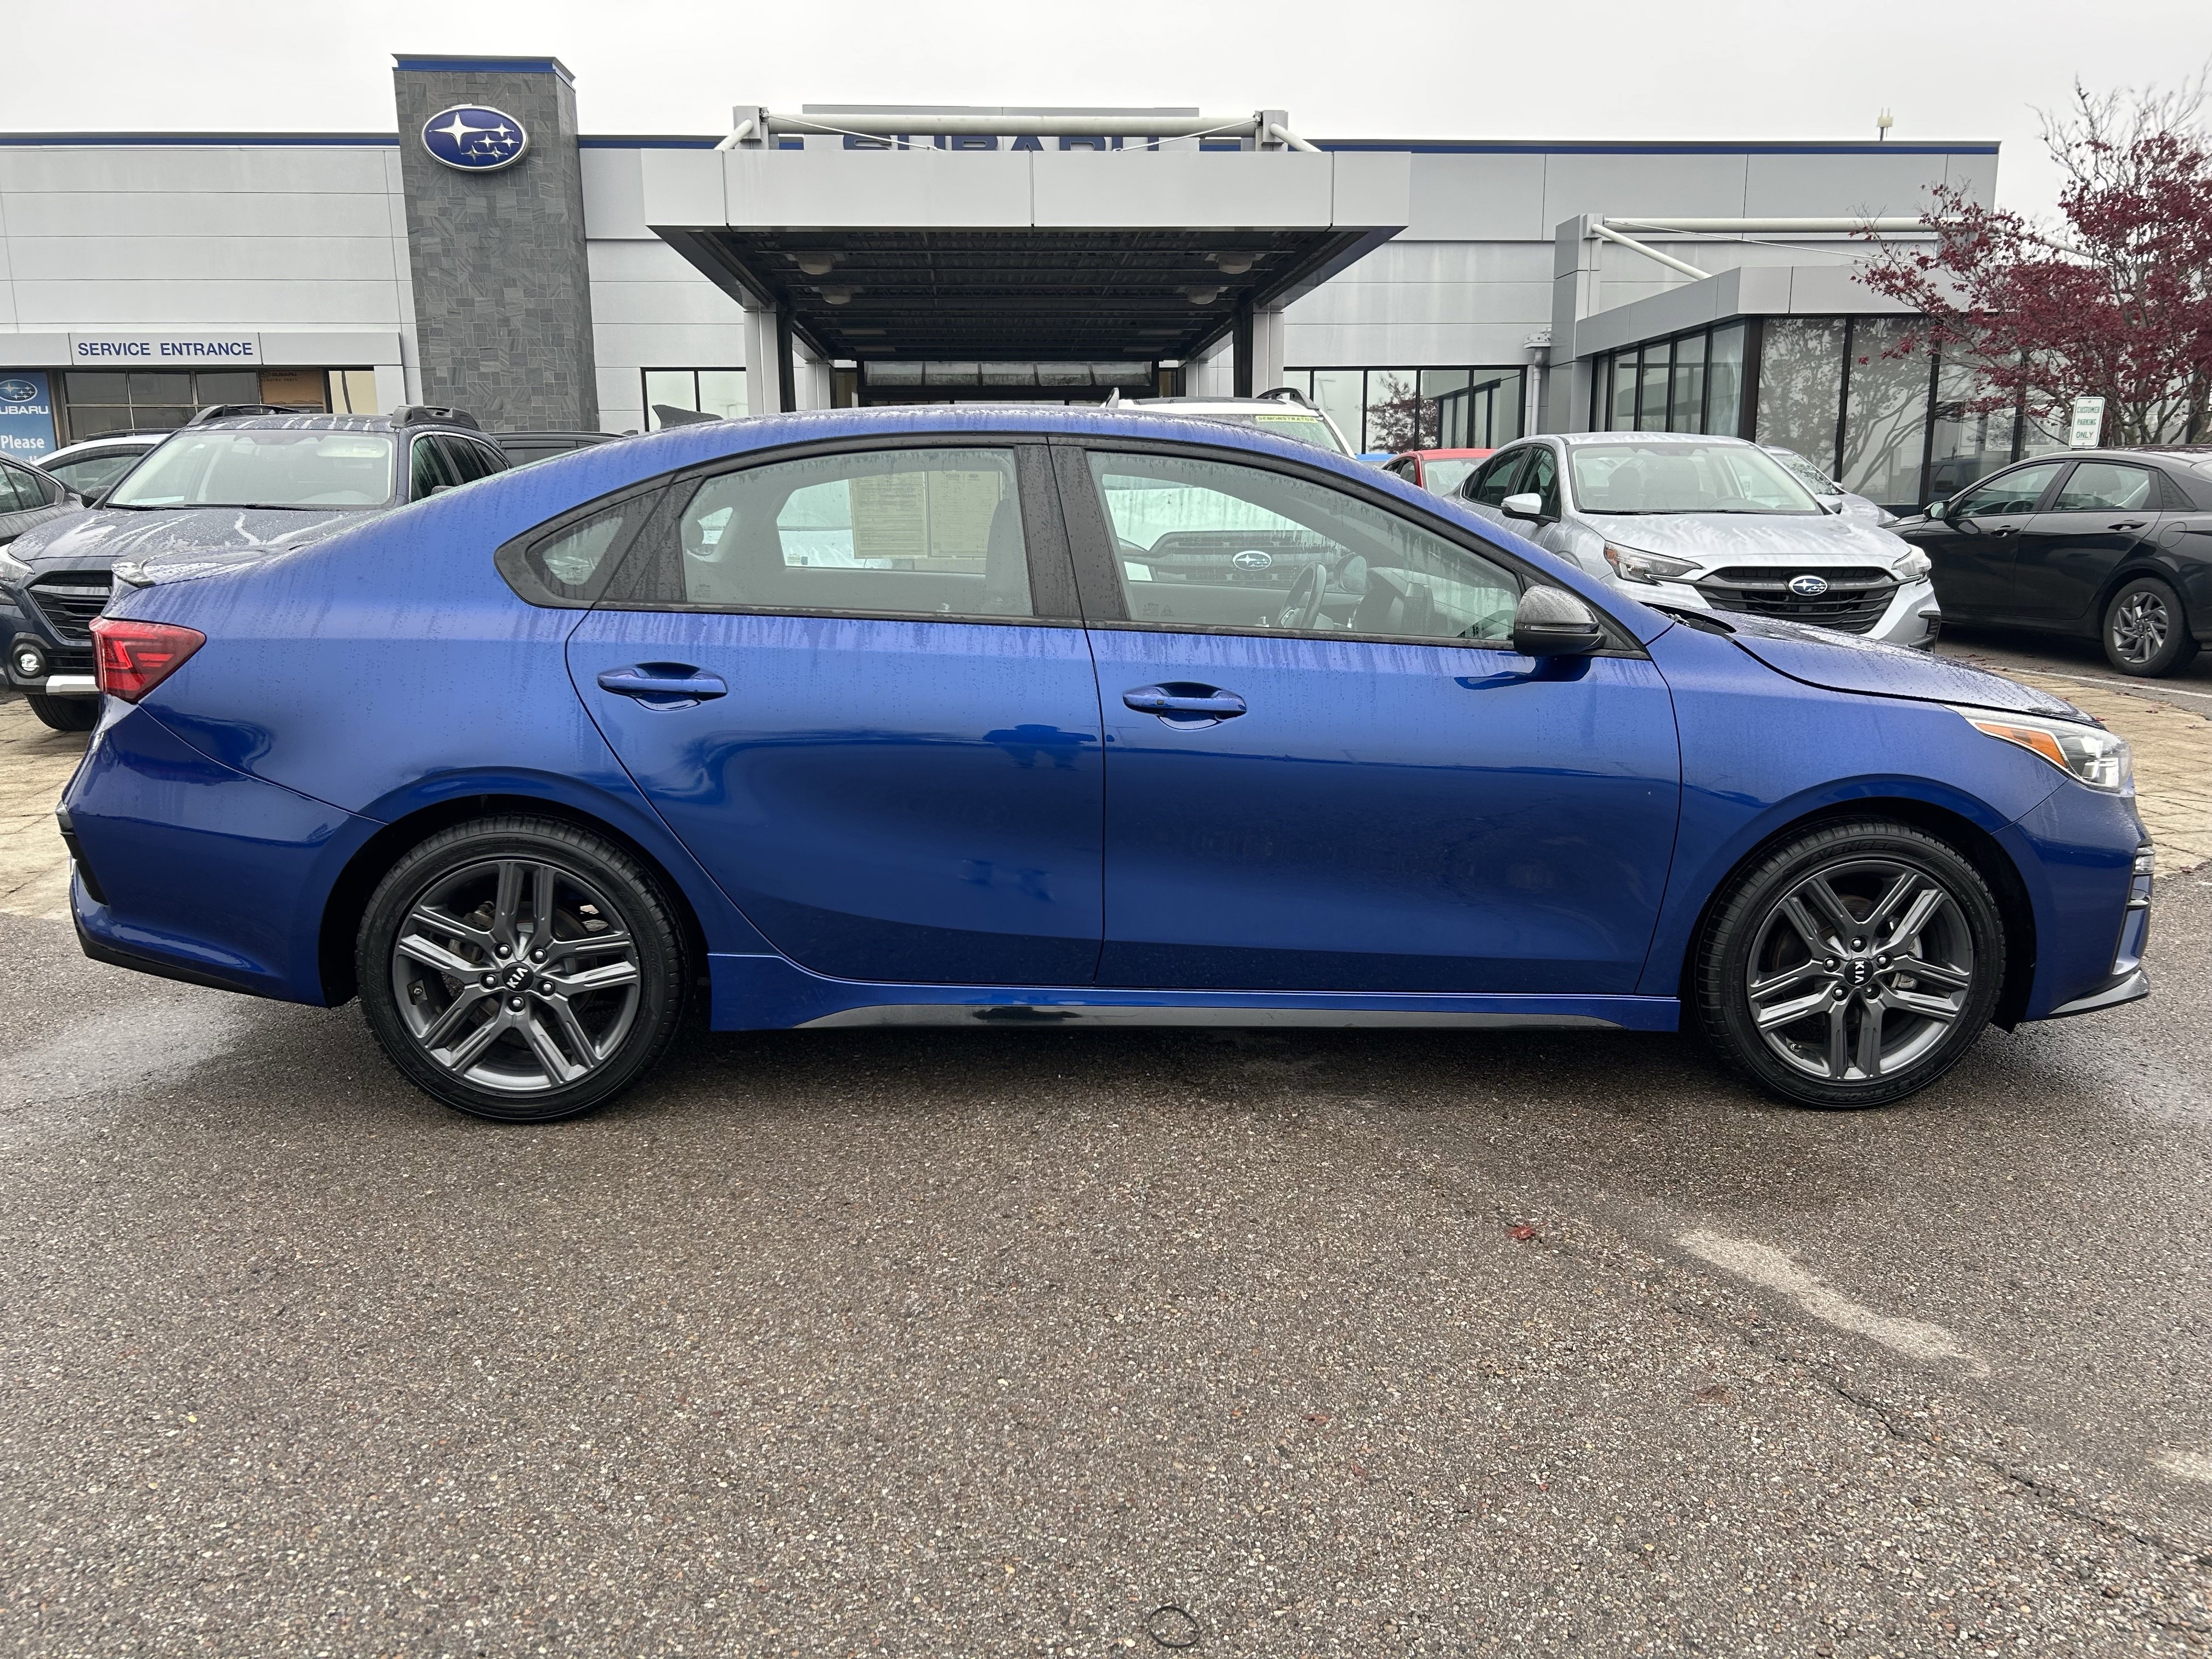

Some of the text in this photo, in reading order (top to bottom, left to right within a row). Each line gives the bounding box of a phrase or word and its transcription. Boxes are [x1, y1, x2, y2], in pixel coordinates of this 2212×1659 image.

[78, 342, 253, 356] SERVICE ENTRANCE
[0, 405, 49, 415] UBARU
[0, 435, 45, 449] Please
[1809, 839, 1901, 864] AVENGER
[506, 968, 528, 989] KIA
[1855, 961, 1864, 984] KIA
